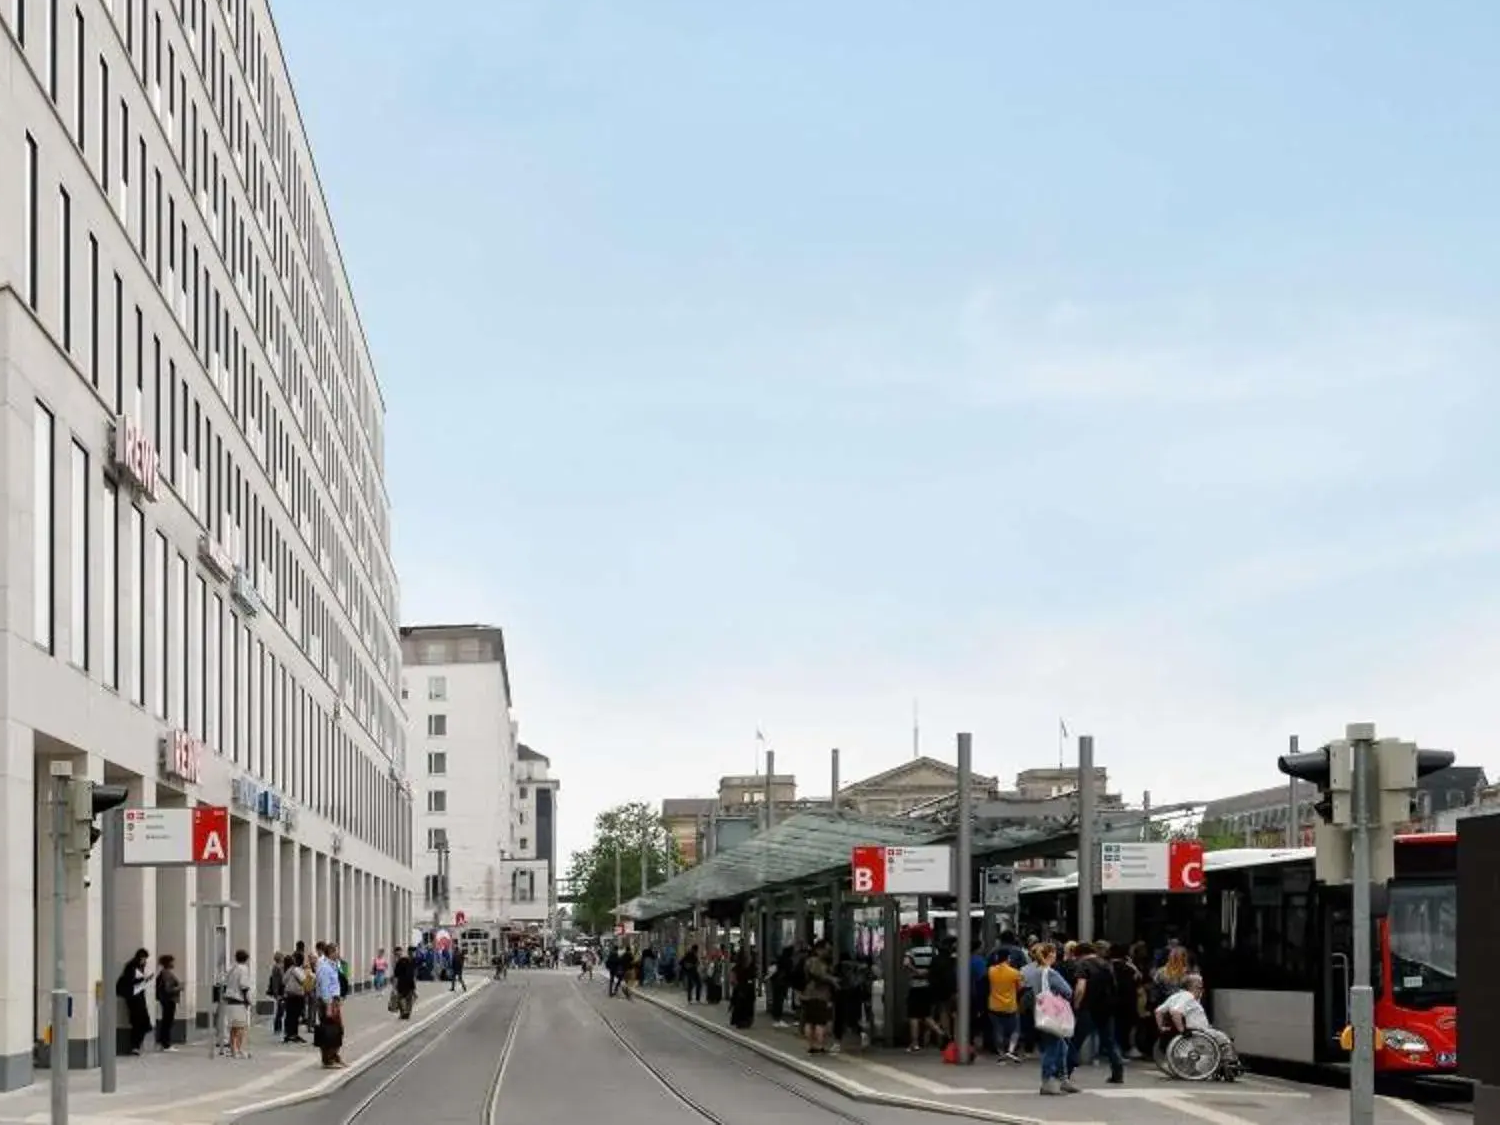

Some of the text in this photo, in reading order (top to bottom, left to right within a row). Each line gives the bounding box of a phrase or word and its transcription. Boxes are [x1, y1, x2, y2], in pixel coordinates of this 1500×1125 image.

[202, 830, 225, 860] A
[855, 867, 873, 892] B
[1181, 862, 1202, 888] C
